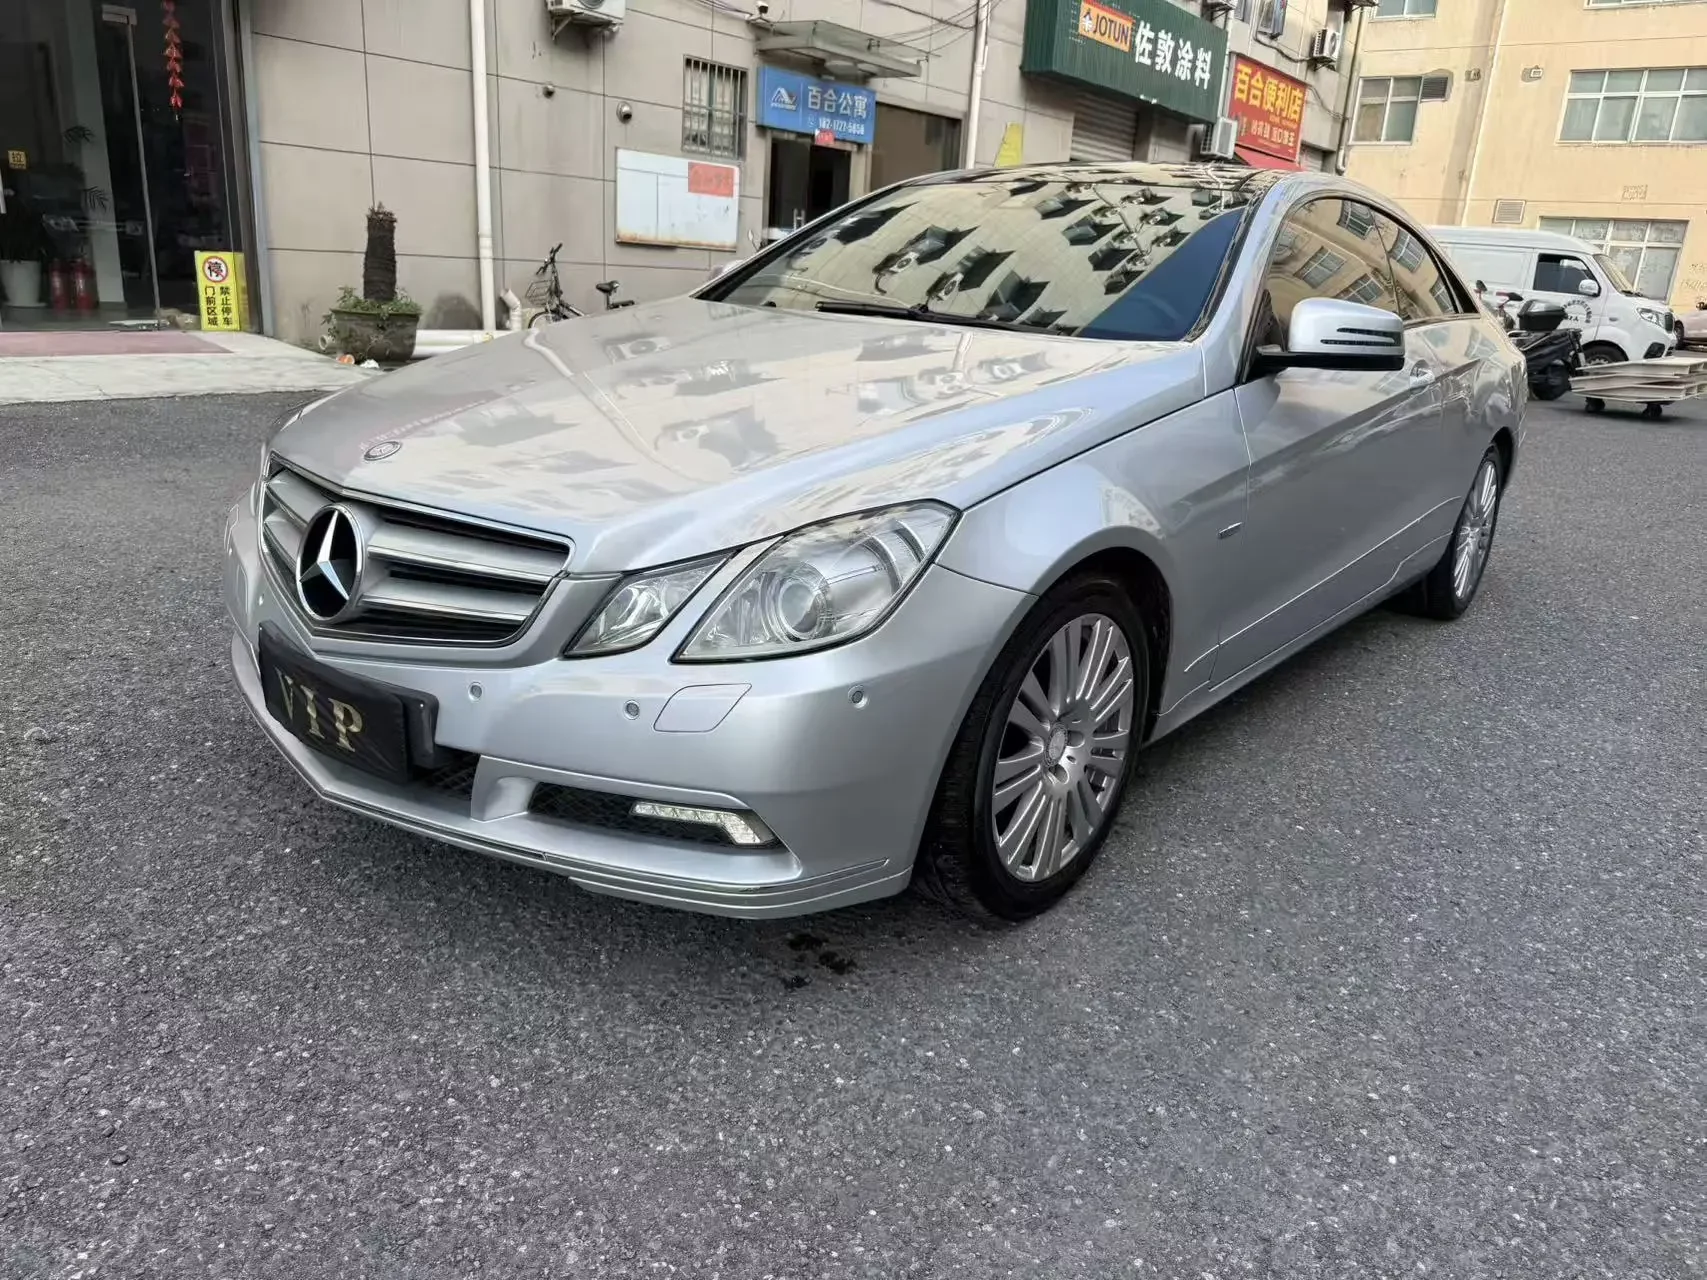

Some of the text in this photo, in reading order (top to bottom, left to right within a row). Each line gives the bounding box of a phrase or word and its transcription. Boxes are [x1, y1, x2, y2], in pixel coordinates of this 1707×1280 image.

[1094, 14, 1129, 44] JOTUN
[1135, 21, 1211, 90] 佐敦涂料
[807, 85, 868, 119] 百合公寓
[1235, 64, 1303, 121] 百合便利店
[204, 285, 219, 327] 门前区域
[220, 286, 233, 326] 禁止停车
[275, 667, 363, 752] VIP
